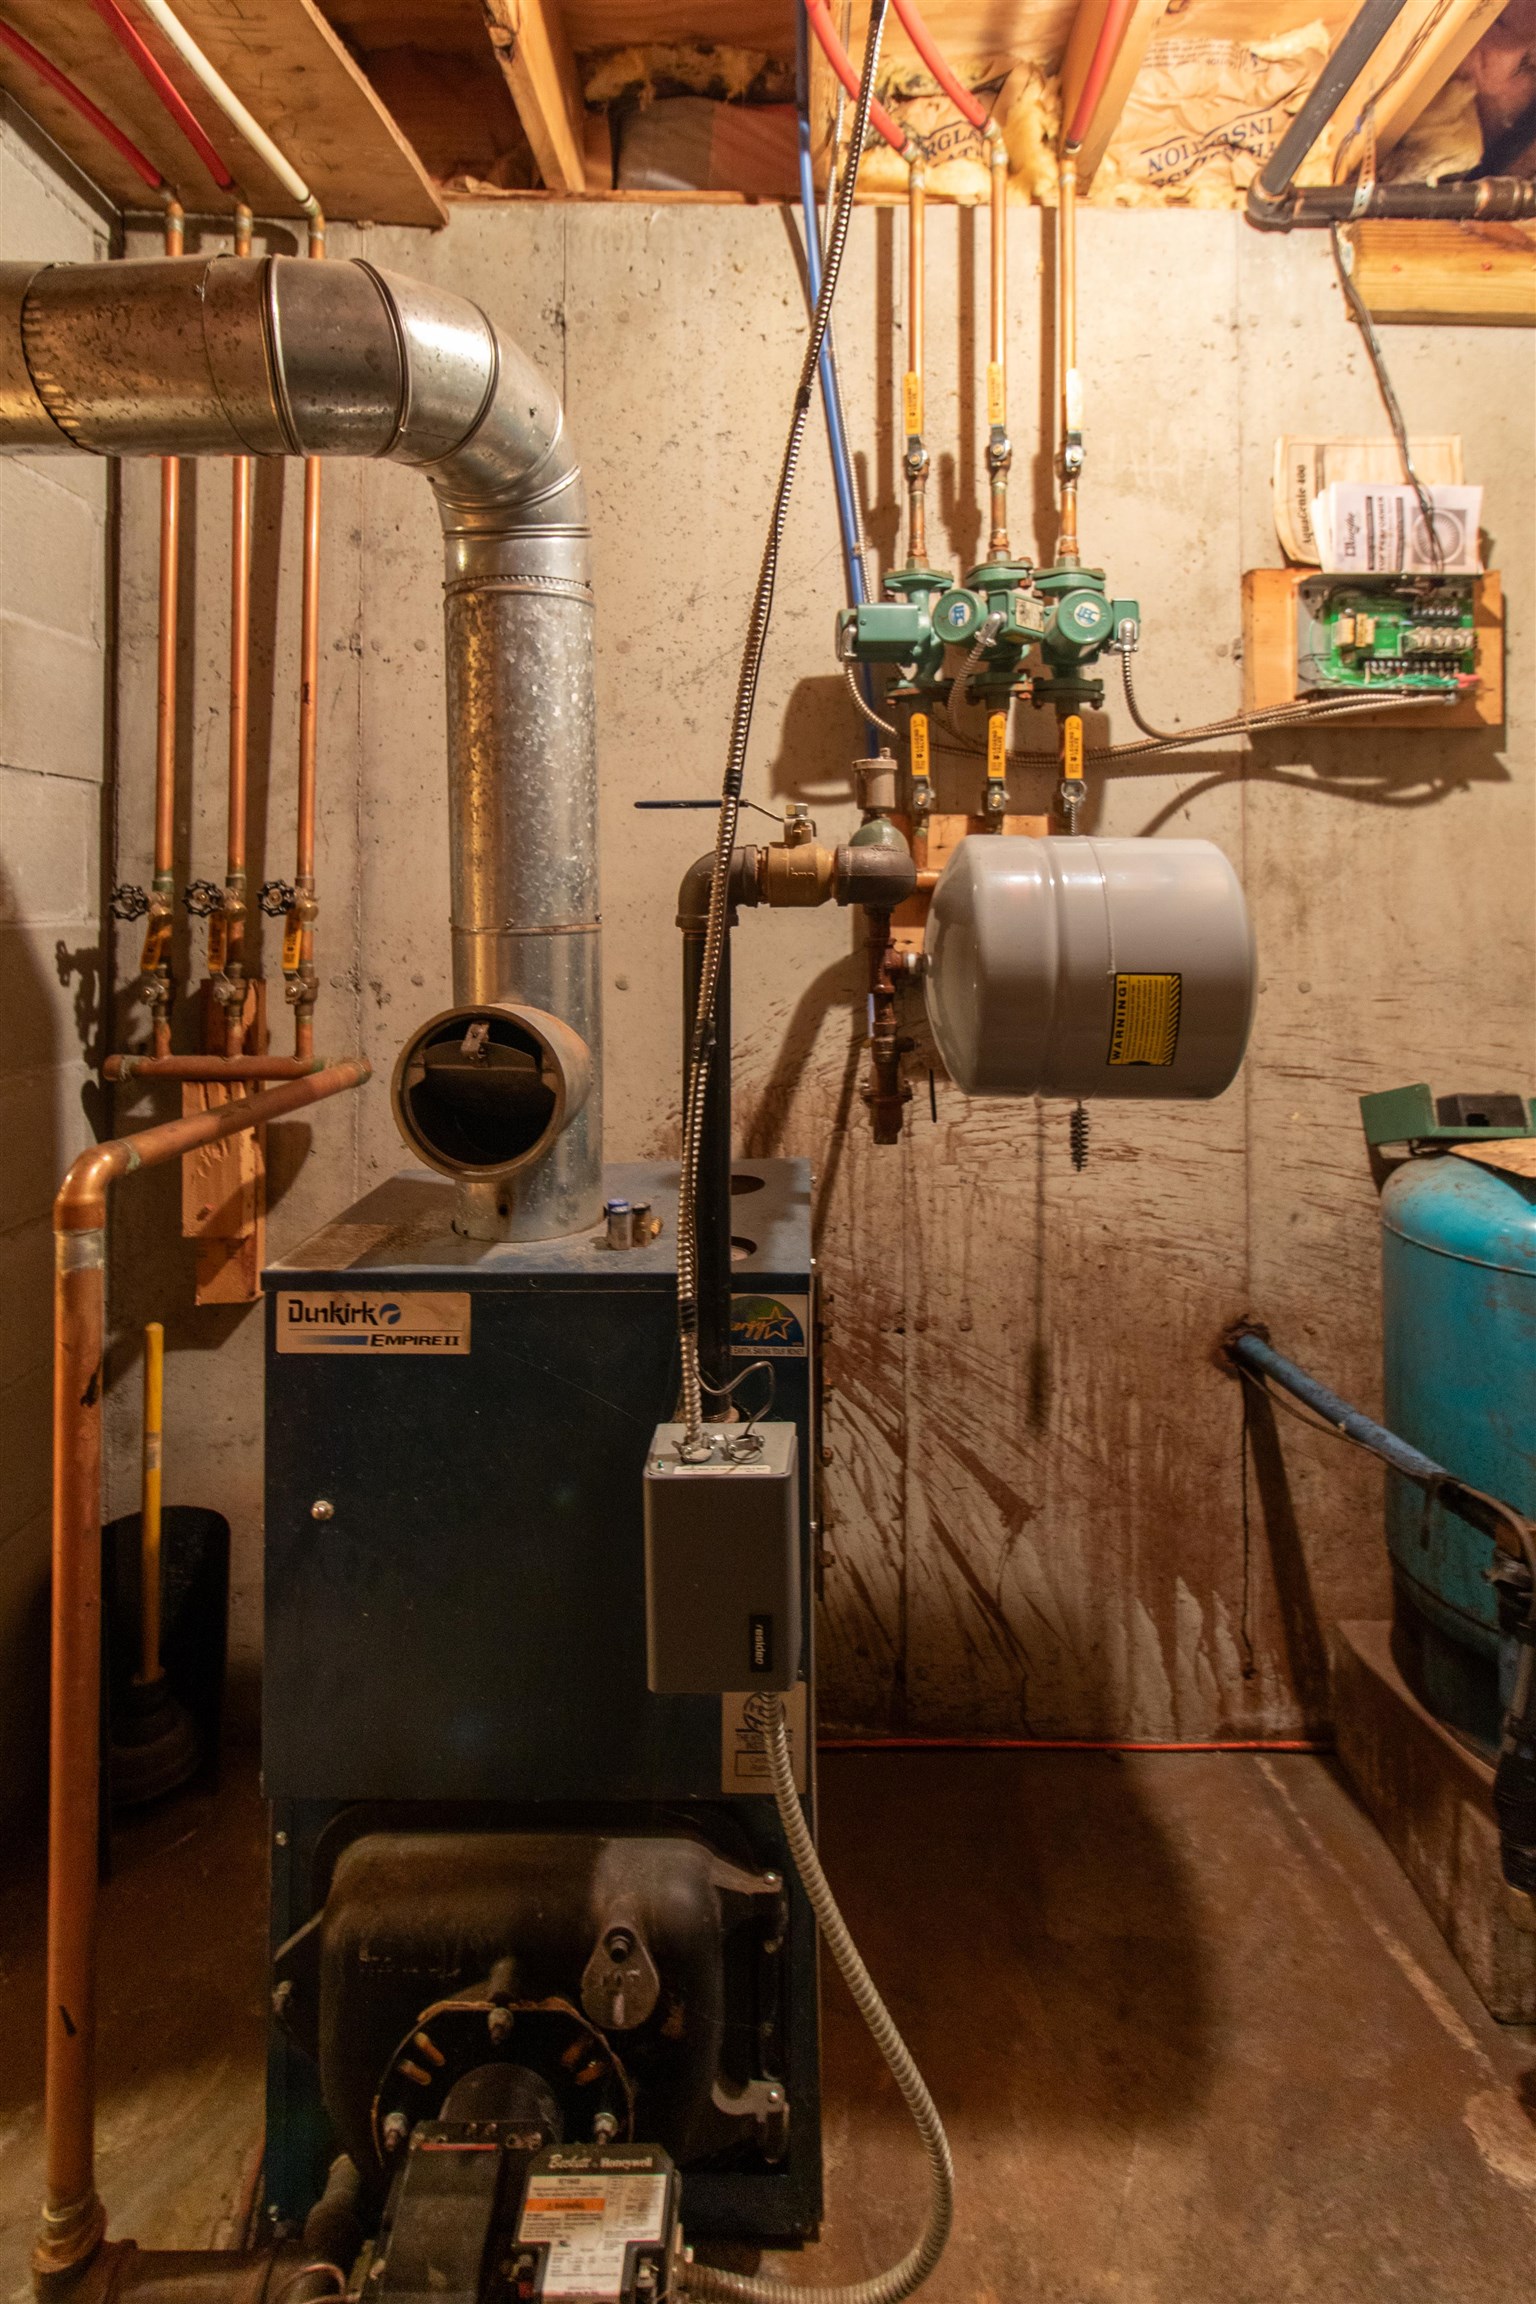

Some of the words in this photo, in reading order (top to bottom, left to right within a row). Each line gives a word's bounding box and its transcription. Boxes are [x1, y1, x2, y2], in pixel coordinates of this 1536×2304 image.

[1111, 980, 1127, 1060] WARNING!
[288, 1299, 379, 1325] Dunkirk
[600, 2157, 653, 2169] Honeywell
